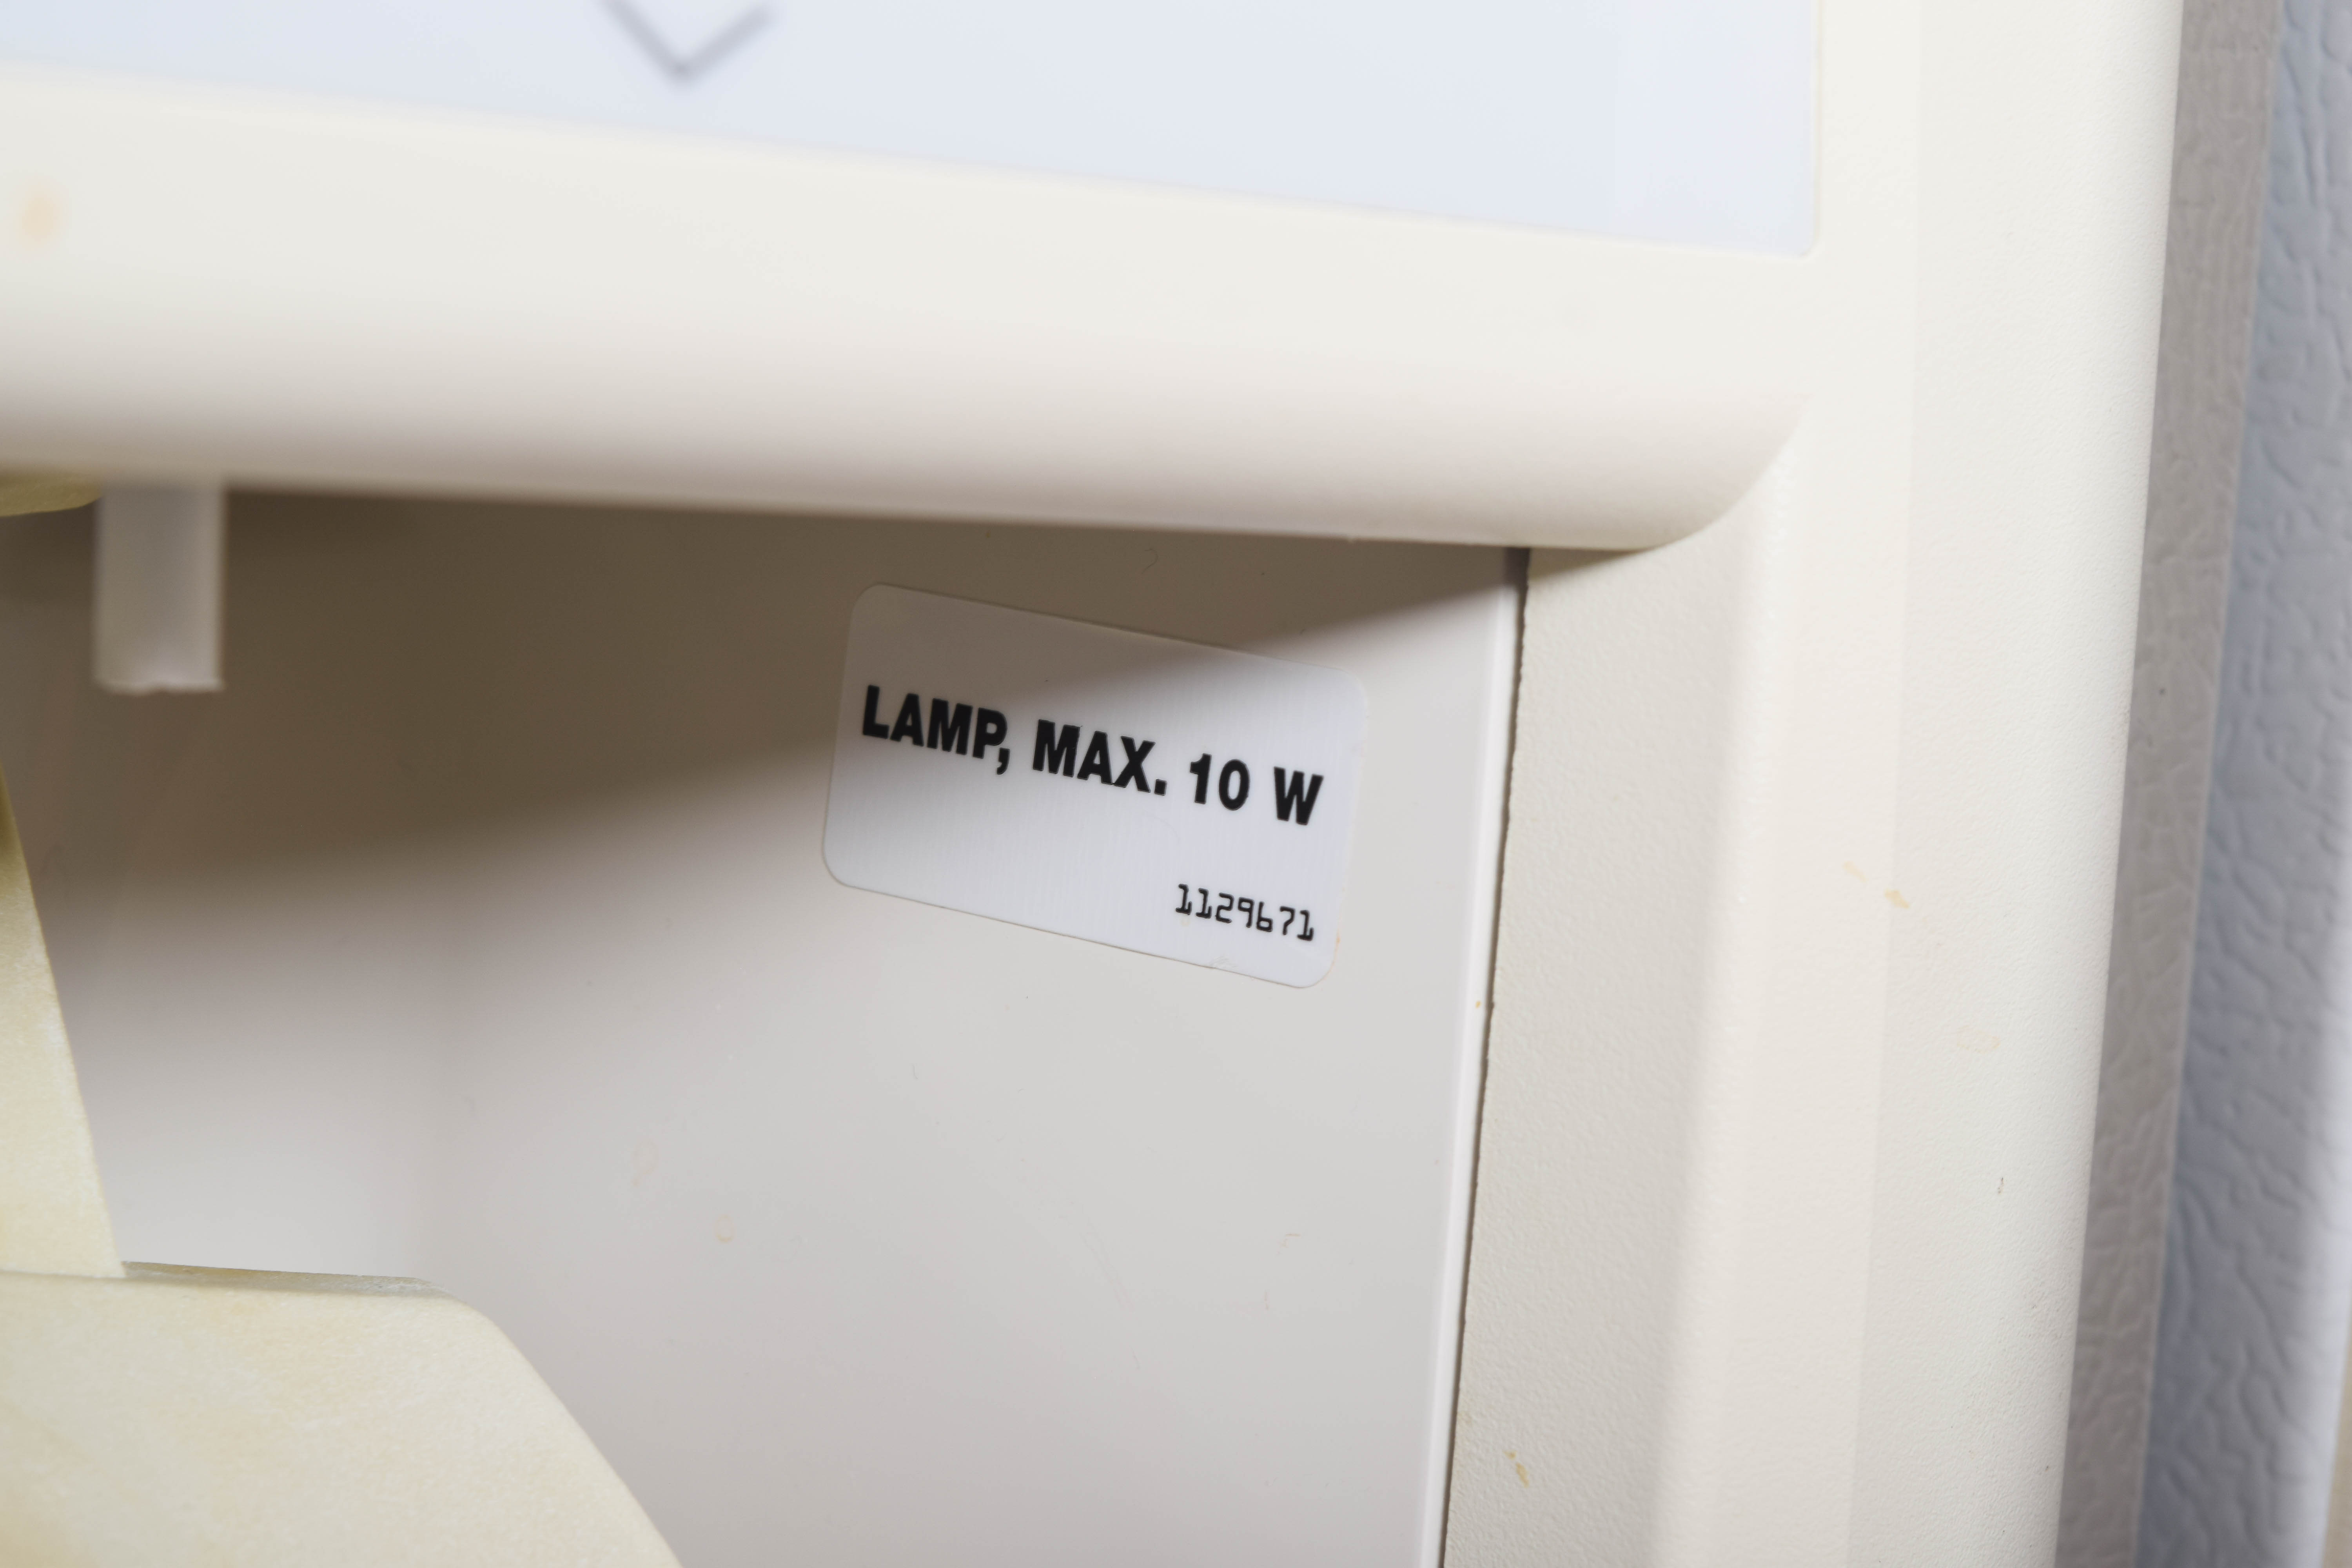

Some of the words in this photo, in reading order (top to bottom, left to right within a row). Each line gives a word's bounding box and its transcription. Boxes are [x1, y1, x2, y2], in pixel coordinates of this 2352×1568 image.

[862, 684, 1011, 775] LAMP,
[1032, 719, 1167, 797] MAX.
[1189, 753, 1250, 811] 10
[1273, 766, 1324, 826] W
[1174, 883, 1314, 942] 1129671
